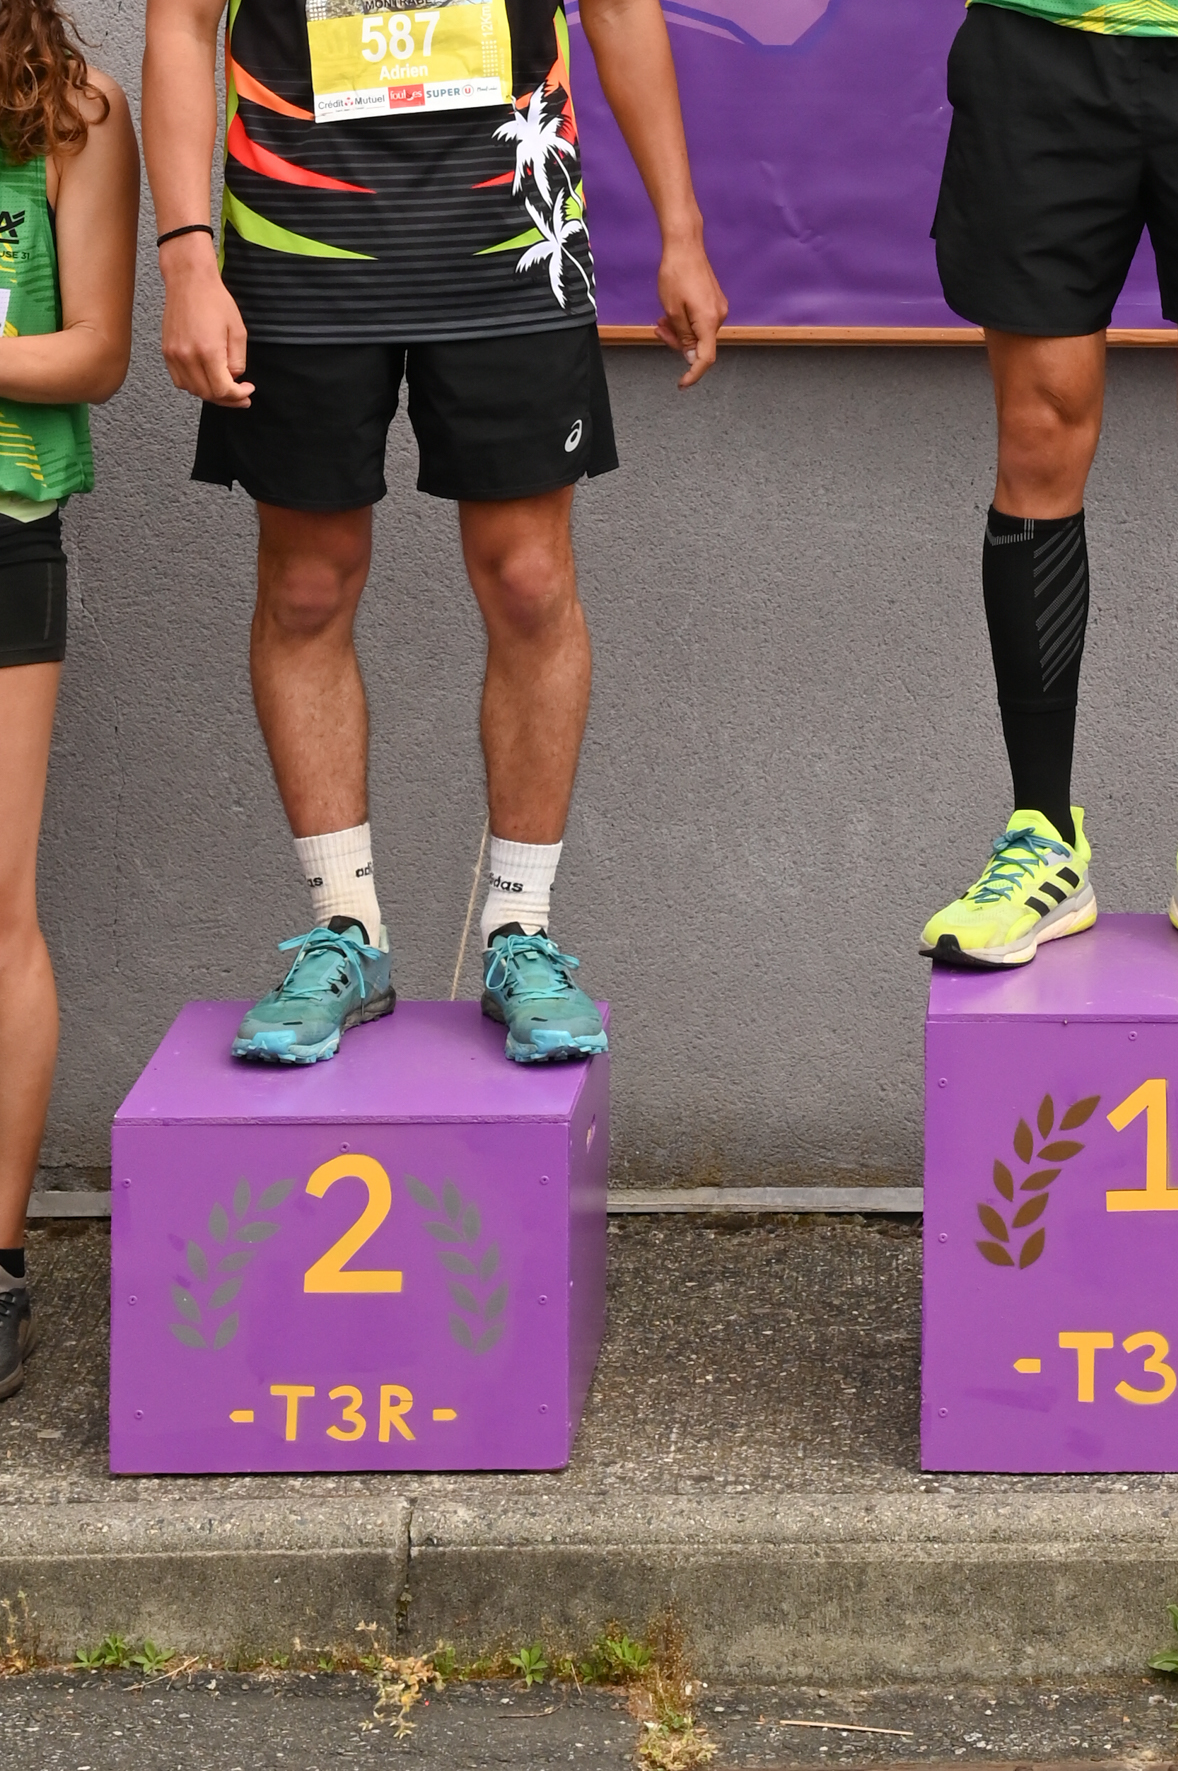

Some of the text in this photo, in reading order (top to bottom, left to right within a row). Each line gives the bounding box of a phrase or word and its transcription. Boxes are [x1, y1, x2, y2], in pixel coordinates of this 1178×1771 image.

[361, 11, 440, 62] 587
[379, 64, 428, 81] Adrien
[426, 88, 460, 98] SUPER
[318, 100, 343, 110] Crédit
[355, 95, 385, 105] Mutuel
[21, 251, 30, 260] 31
[304, 1154, 402, 1293] 2
